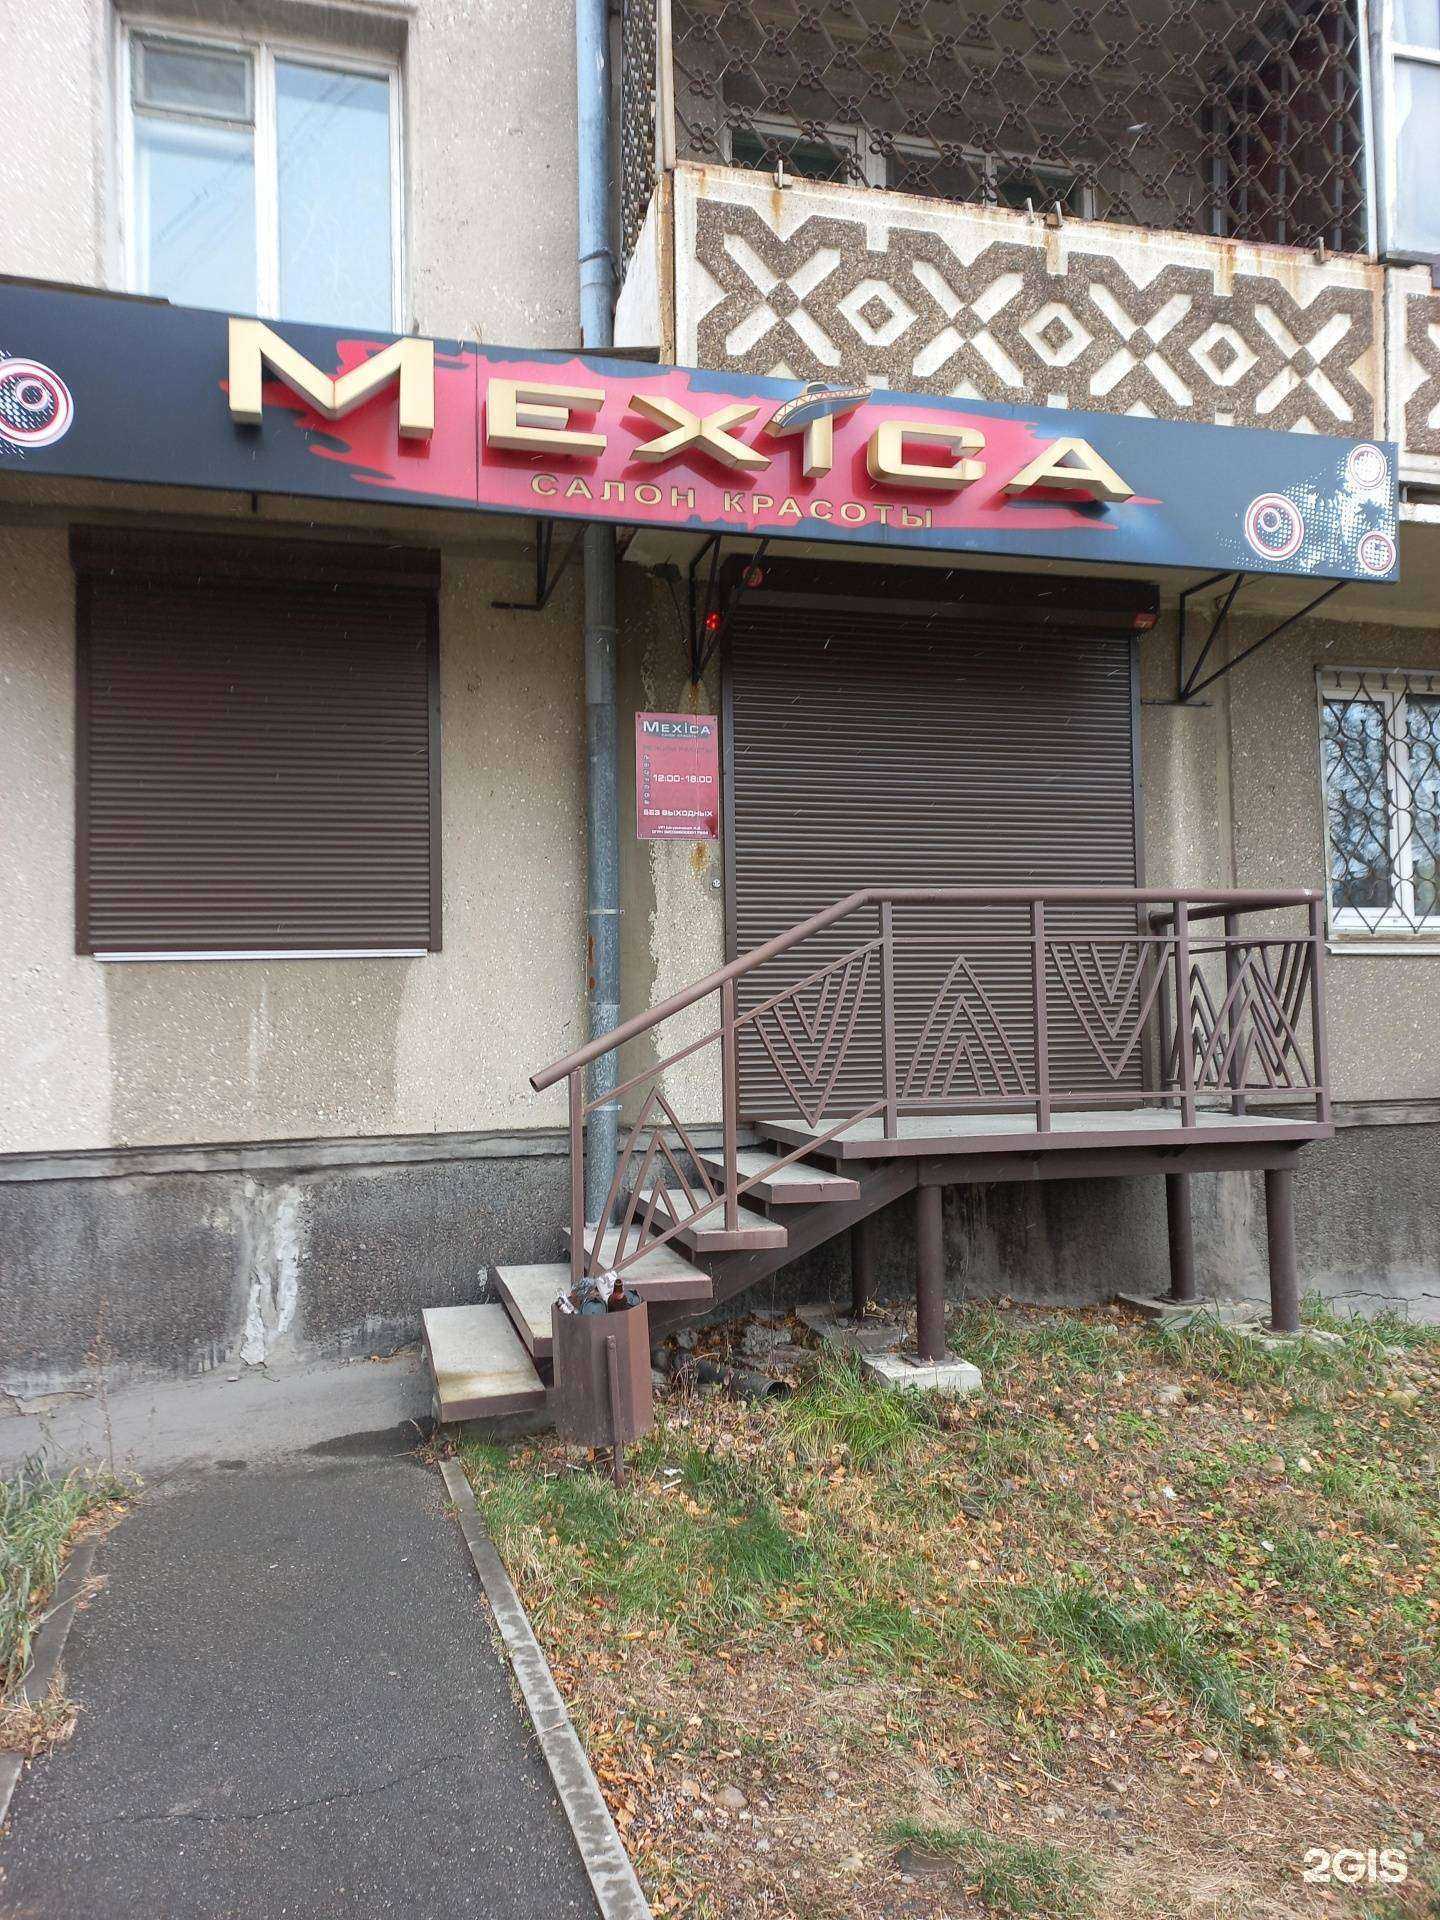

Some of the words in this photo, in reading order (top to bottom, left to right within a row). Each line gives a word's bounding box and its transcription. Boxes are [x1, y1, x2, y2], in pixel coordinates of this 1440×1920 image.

[530, 473, 697, 508] САЛОН
[723, 491, 935, 528] КРАСОТЫ
[653, 774, 713, 783] 12:00-18:00
[643, 808, 661, 816] БЕЗ
[661, 809, 713, 817] ВЫХОДНЫХ
